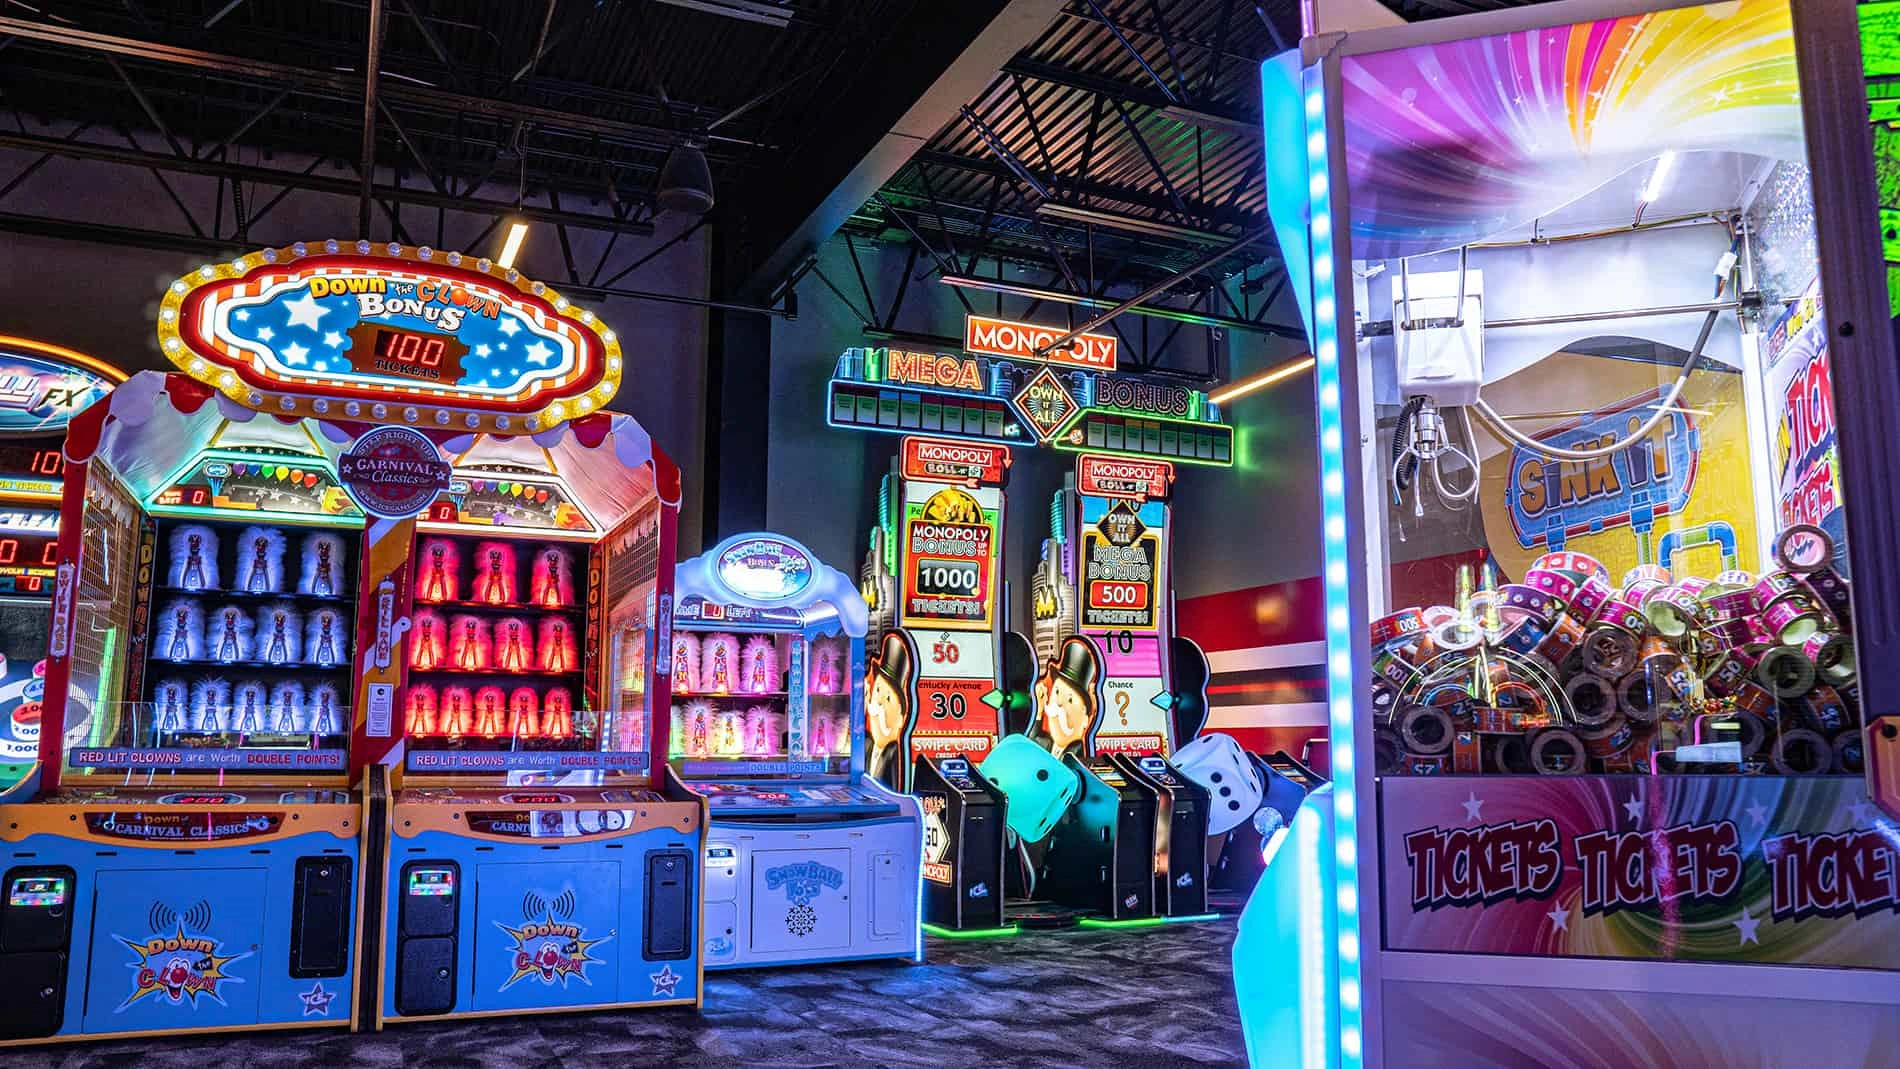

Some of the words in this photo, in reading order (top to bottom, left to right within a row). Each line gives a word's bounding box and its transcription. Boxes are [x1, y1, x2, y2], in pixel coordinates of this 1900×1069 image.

[387, 334, 445, 366] 100
[375, 359, 440, 379] TICKETS
[888, 350, 983, 391] MEGA
[1030, 386, 1063, 400] OWN
[1096, 377, 1189, 415] BONUS
[1035, 411, 1057, 424] ALL
[31, 452, 65, 474] 10
[921, 447, 991, 464] MONOPOLY
[1094, 467, 1155, 480] MONOPOLY
[913, 526, 989, 541] MONOPOLY
[912, 538, 976, 556] BONUS
[1093, 545, 1147, 563] MEGA
[921, 567, 977, 589] 1000
[1088, 562, 1150, 581] BONUS
[1102, 586, 1136, 604] 500
[1104, 630, 1133, 654] 10
[917, 682, 950, 690] entucky
[953, 682, 982, 690] Avenue
[1107, 681, 1134, 689] Chance
[930, 692, 967, 720] 30
[914, 738, 950, 752] SWIPE
[954, 739, 987, 752] CARD
[1130, 738, 1160, 751] CARD
[79, 752, 103, 763] RED
[107, 752, 126, 763] LIT
[130, 752, 181, 763] CLOWNS
[247, 754, 290, 764] DOUBLE
[296, 754, 340, 765] POINTS!
[416, 756, 438, 766] RED
[440, 756, 457, 766] LIT
[460, 756, 504, 767] CLOWNS
[507, 757, 524, 765] are
[529, 756, 556, 766] Worth
[560, 757, 598, 766] DOUBLE
[115, 824, 185, 837] CARNIVAL
[1405, 818, 1563, 912] TICKETS
[1573, 820, 1743, 917] TICKETS
[523, 924, 578, 940] Down
[148, 938, 216, 954] Down
